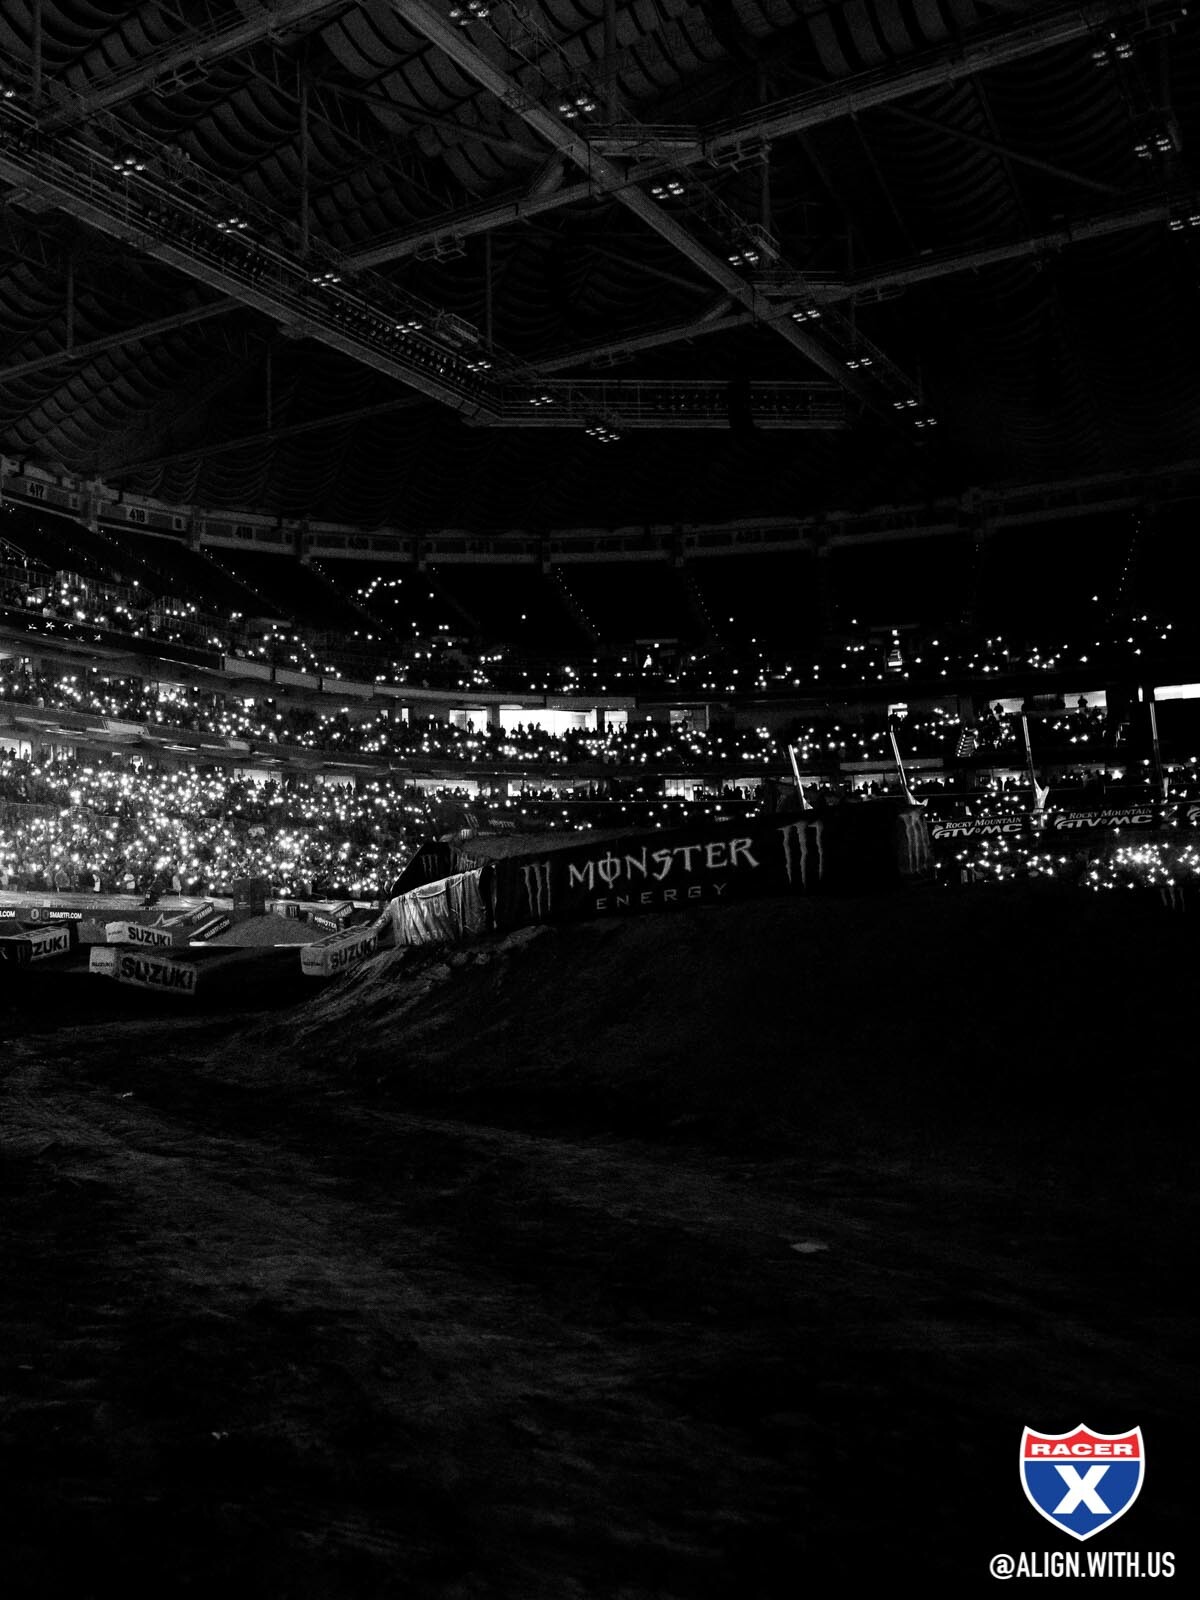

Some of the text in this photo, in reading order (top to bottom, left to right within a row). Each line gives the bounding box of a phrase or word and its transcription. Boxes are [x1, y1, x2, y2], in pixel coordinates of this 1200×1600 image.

[30, 482, 44, 498] 417
[974, 816, 1022, 828] MOUNTAIN
[1100, 807, 1153, 818] MOUNTAIN
[568, 838, 760, 891] MONSTER
[596, 882, 729, 910] ENERGY
[128, 926, 171, 946] SUZUKI
[121, 957, 194, 989] SUZUKI
